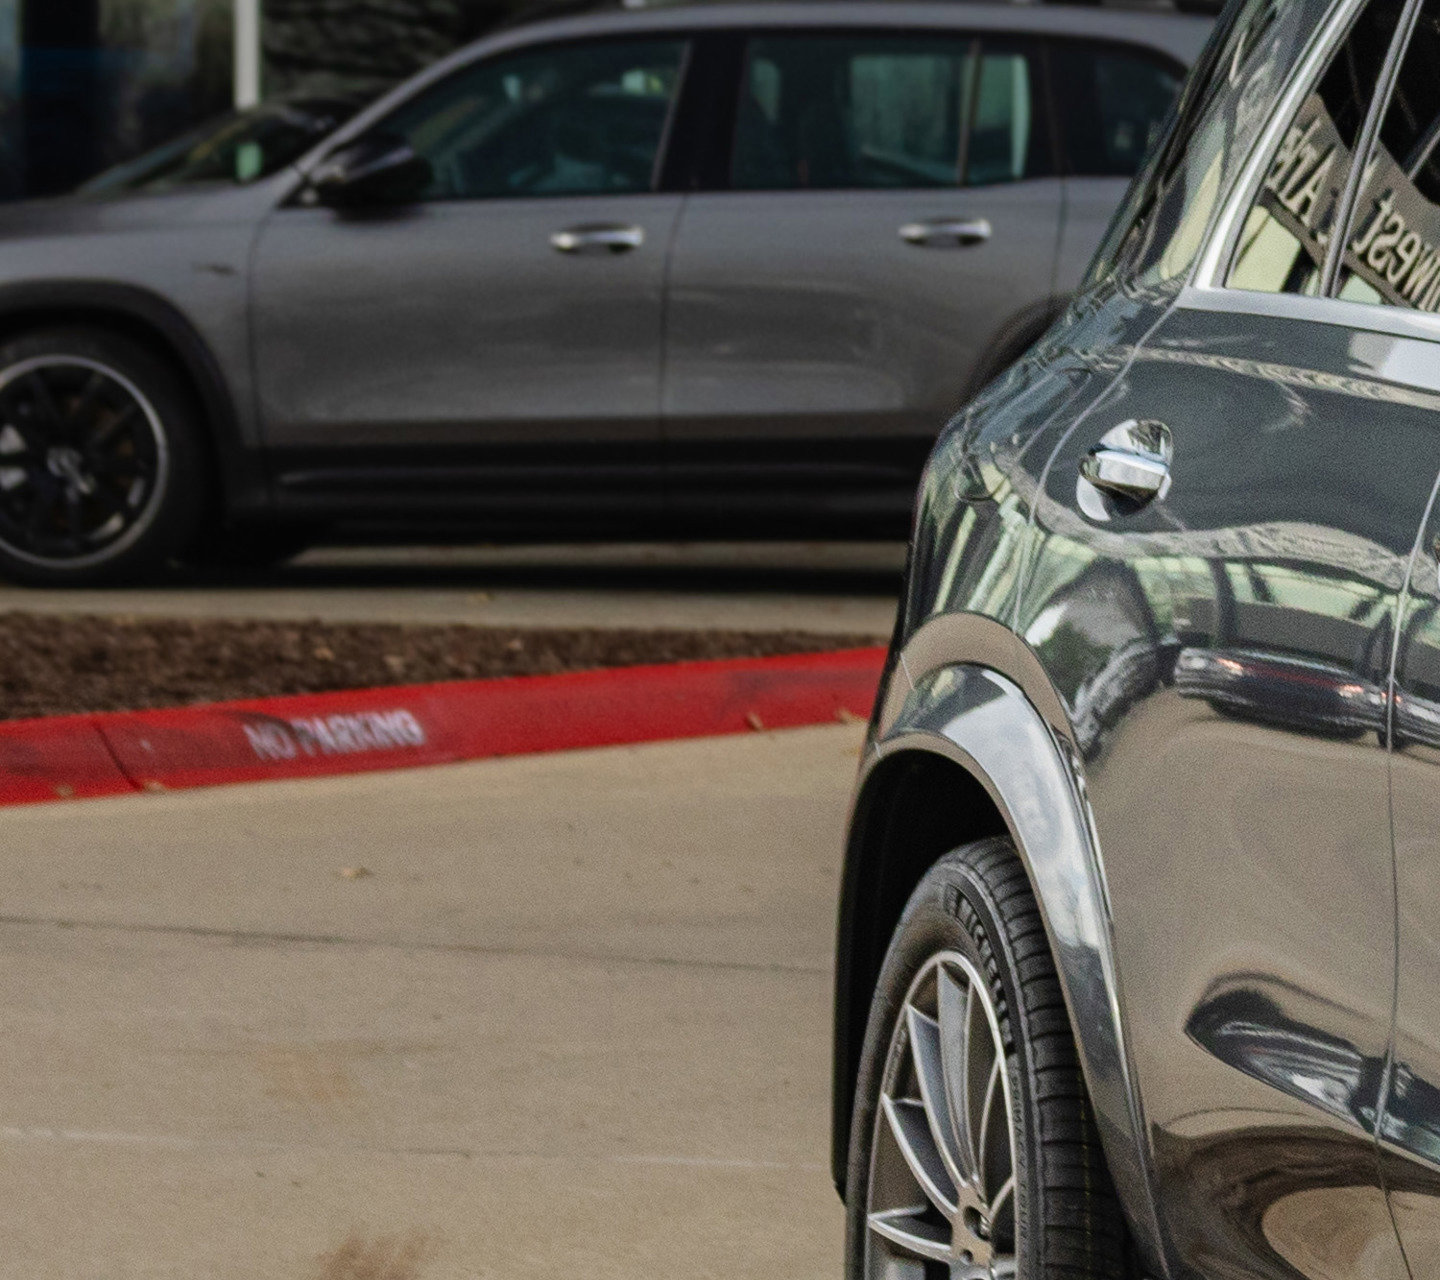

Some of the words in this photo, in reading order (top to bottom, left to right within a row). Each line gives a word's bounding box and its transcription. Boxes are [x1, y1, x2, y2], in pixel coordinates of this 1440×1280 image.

[243, 722, 297, 761] NO
[291, 709, 427, 757] PARKING
[956, 895, 1012, 1044] MICHELIN
